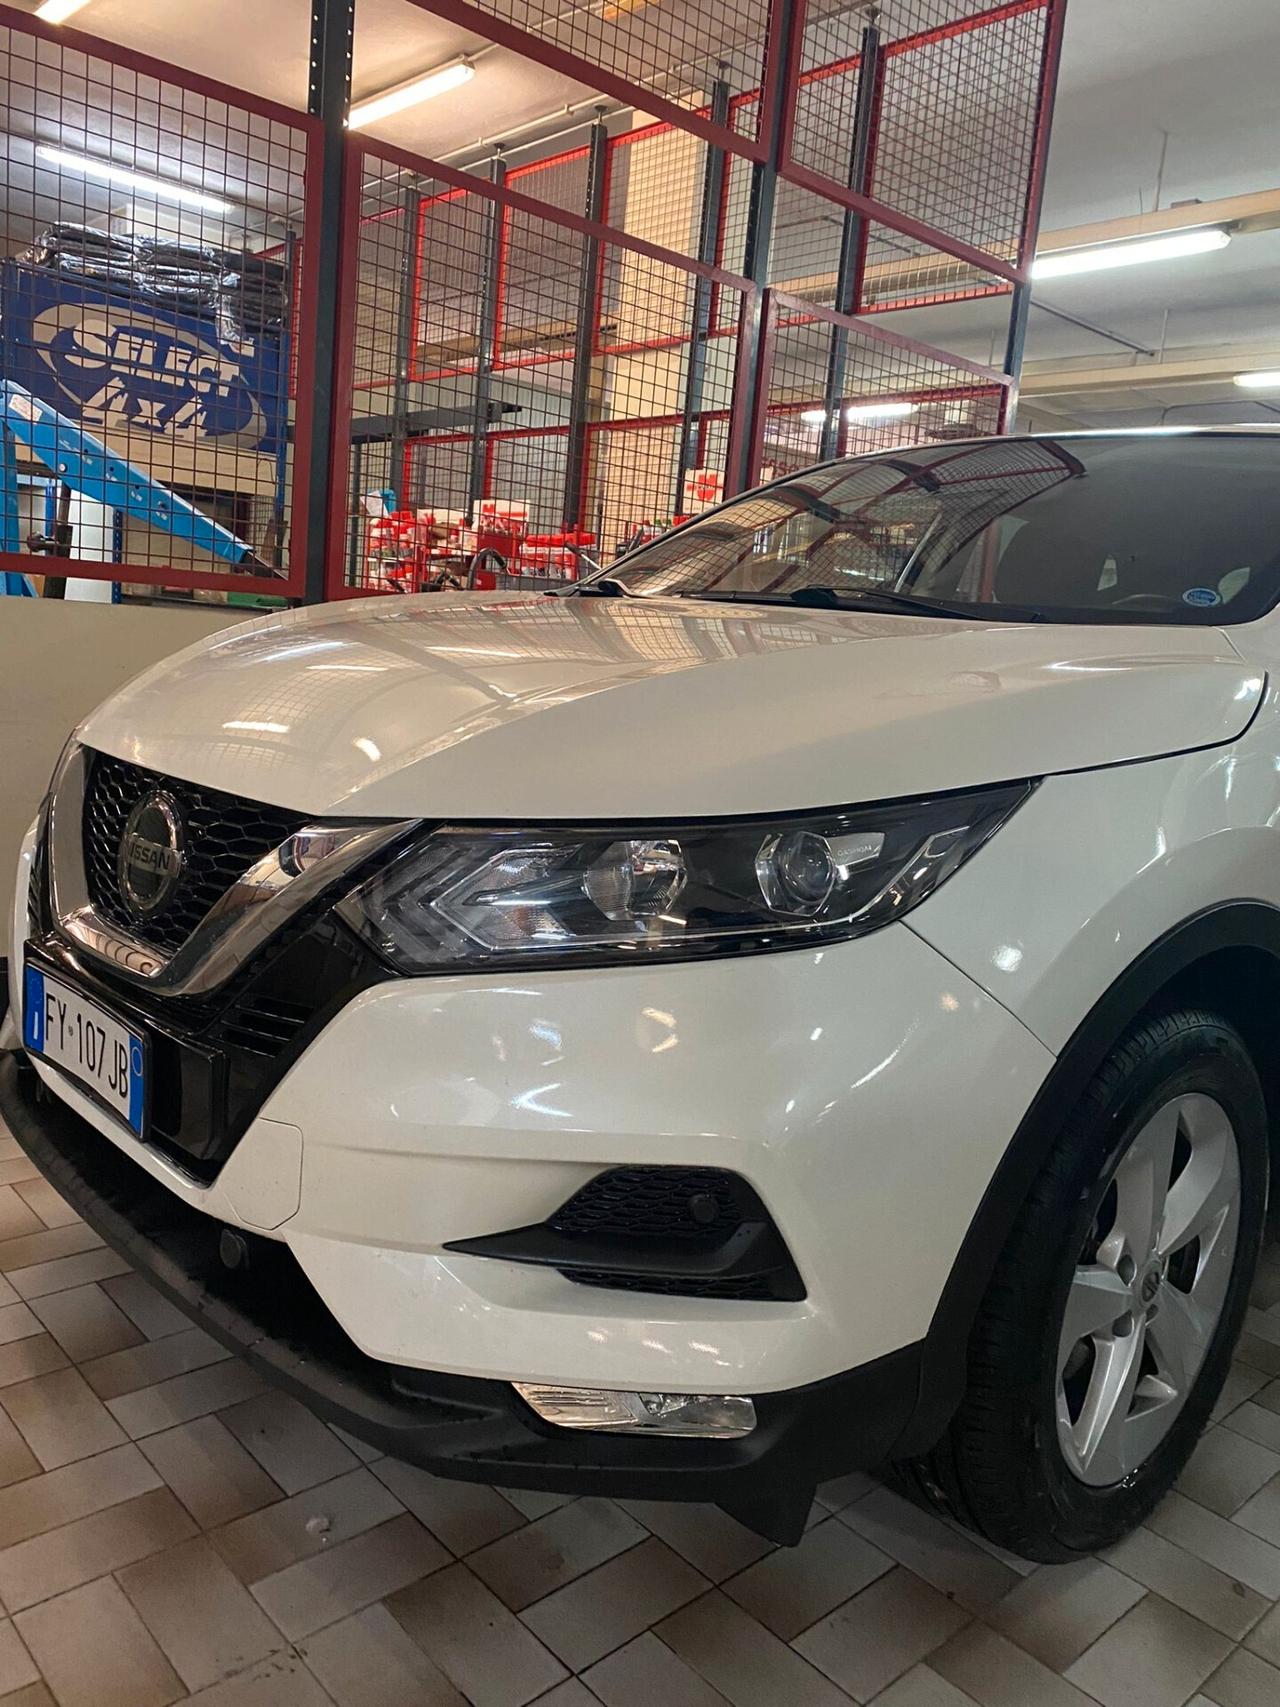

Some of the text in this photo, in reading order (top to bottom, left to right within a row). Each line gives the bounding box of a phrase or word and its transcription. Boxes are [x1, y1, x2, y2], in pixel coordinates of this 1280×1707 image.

[128, 841, 171, 873] ISSAN
[45, 992, 129, 1098] FY 107 JB
